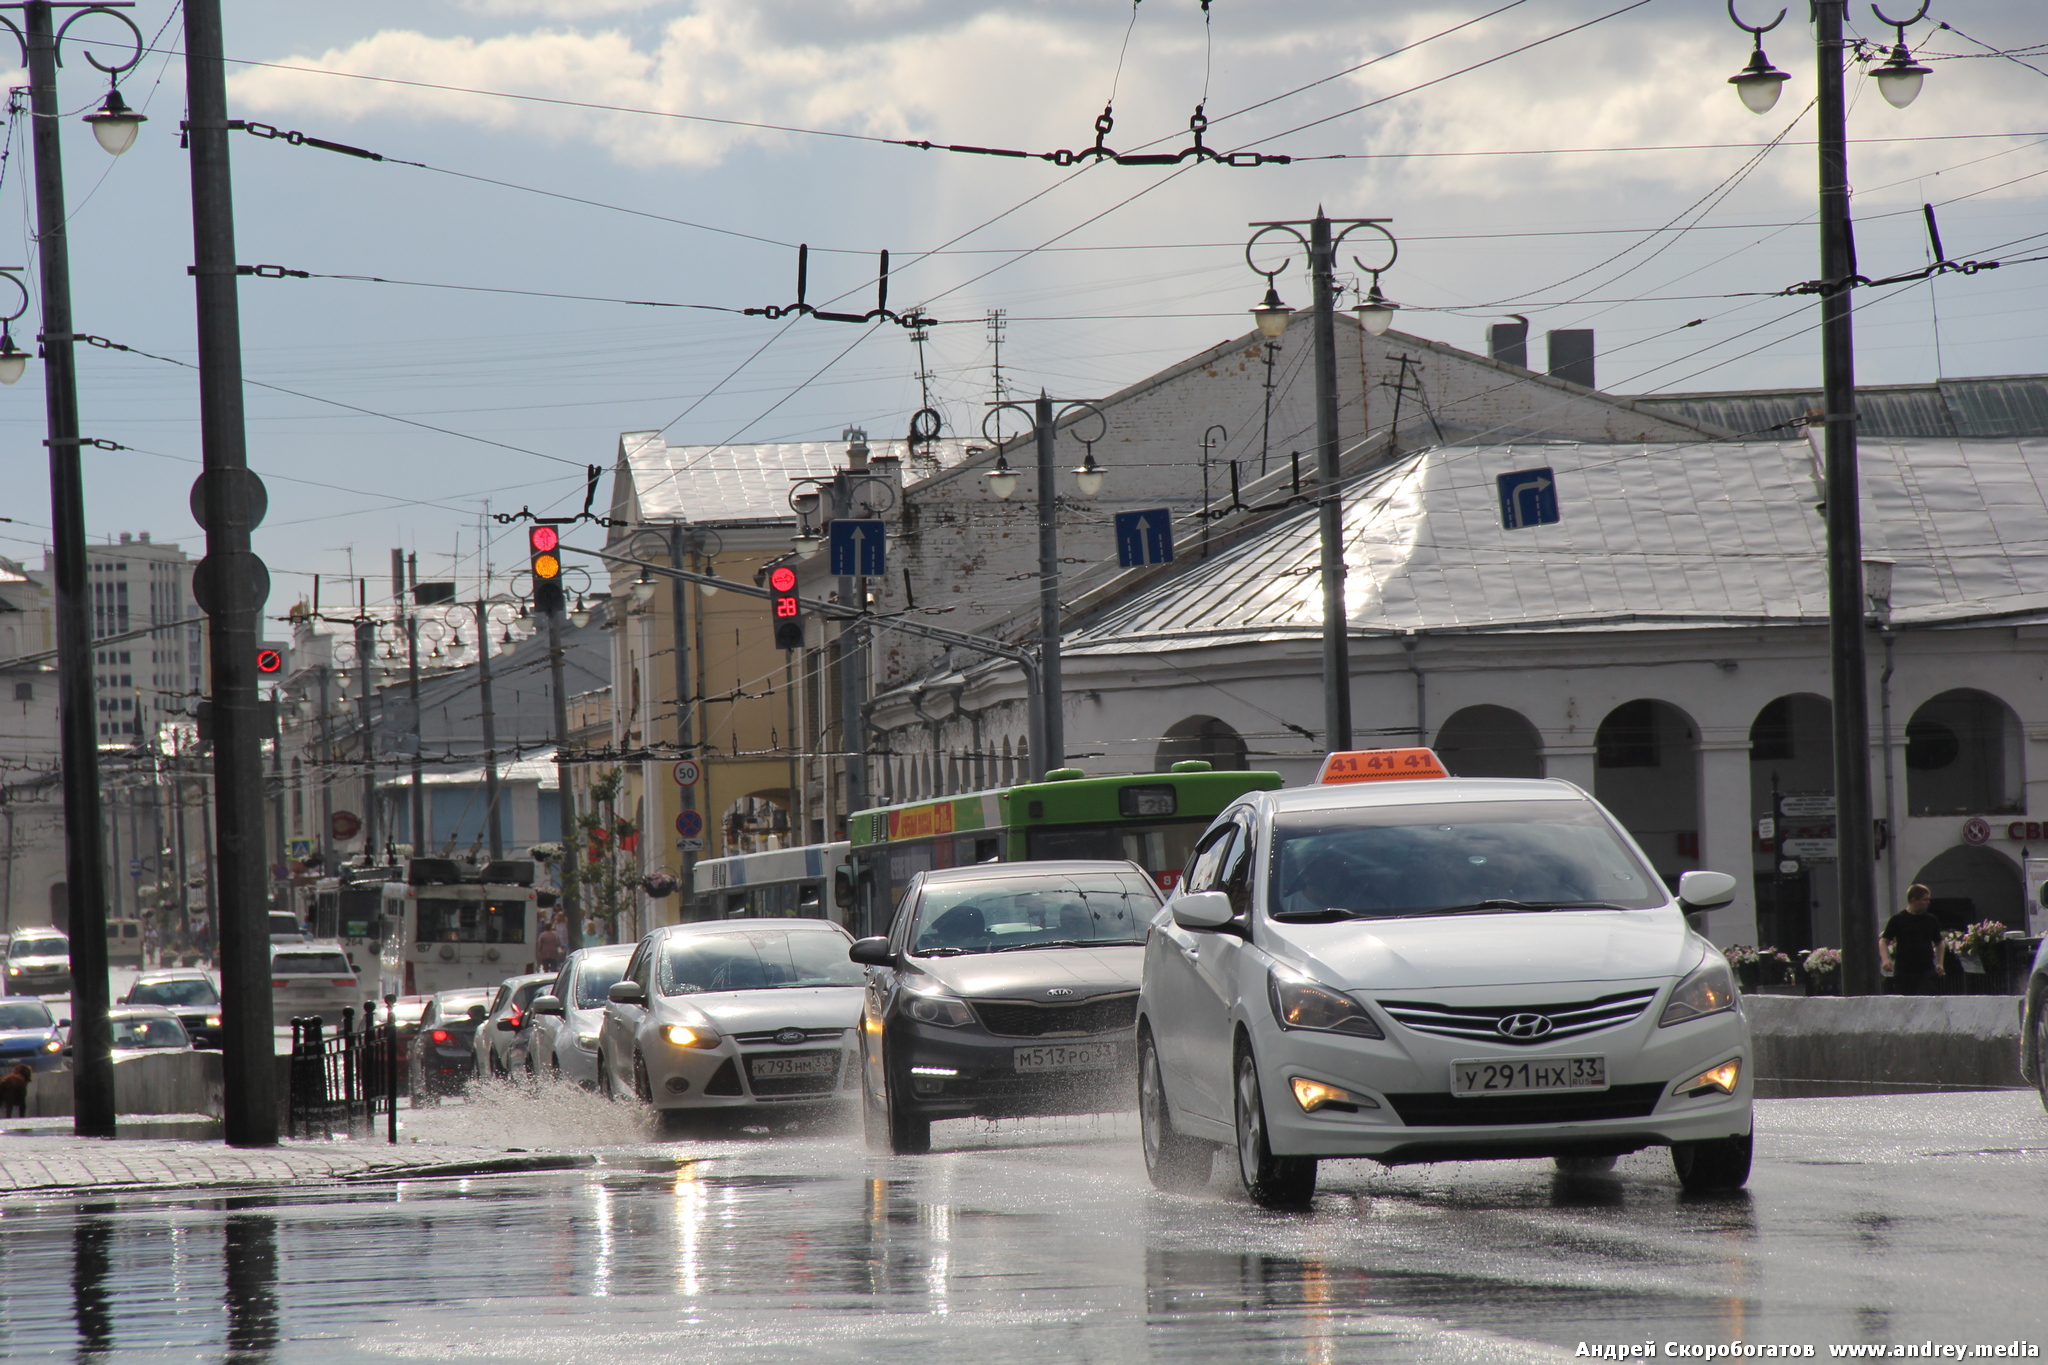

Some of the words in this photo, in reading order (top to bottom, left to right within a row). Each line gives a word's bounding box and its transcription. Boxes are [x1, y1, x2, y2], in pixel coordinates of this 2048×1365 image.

[777, 597, 798, 618] 28
[1330, 757, 1358, 772] 41
[1367, 755, 1395, 770] 41
[1404, 754, 1432, 768] 41
[679, 768, 695, 779] 50
[1572, 1058, 1598, 1078] 33
